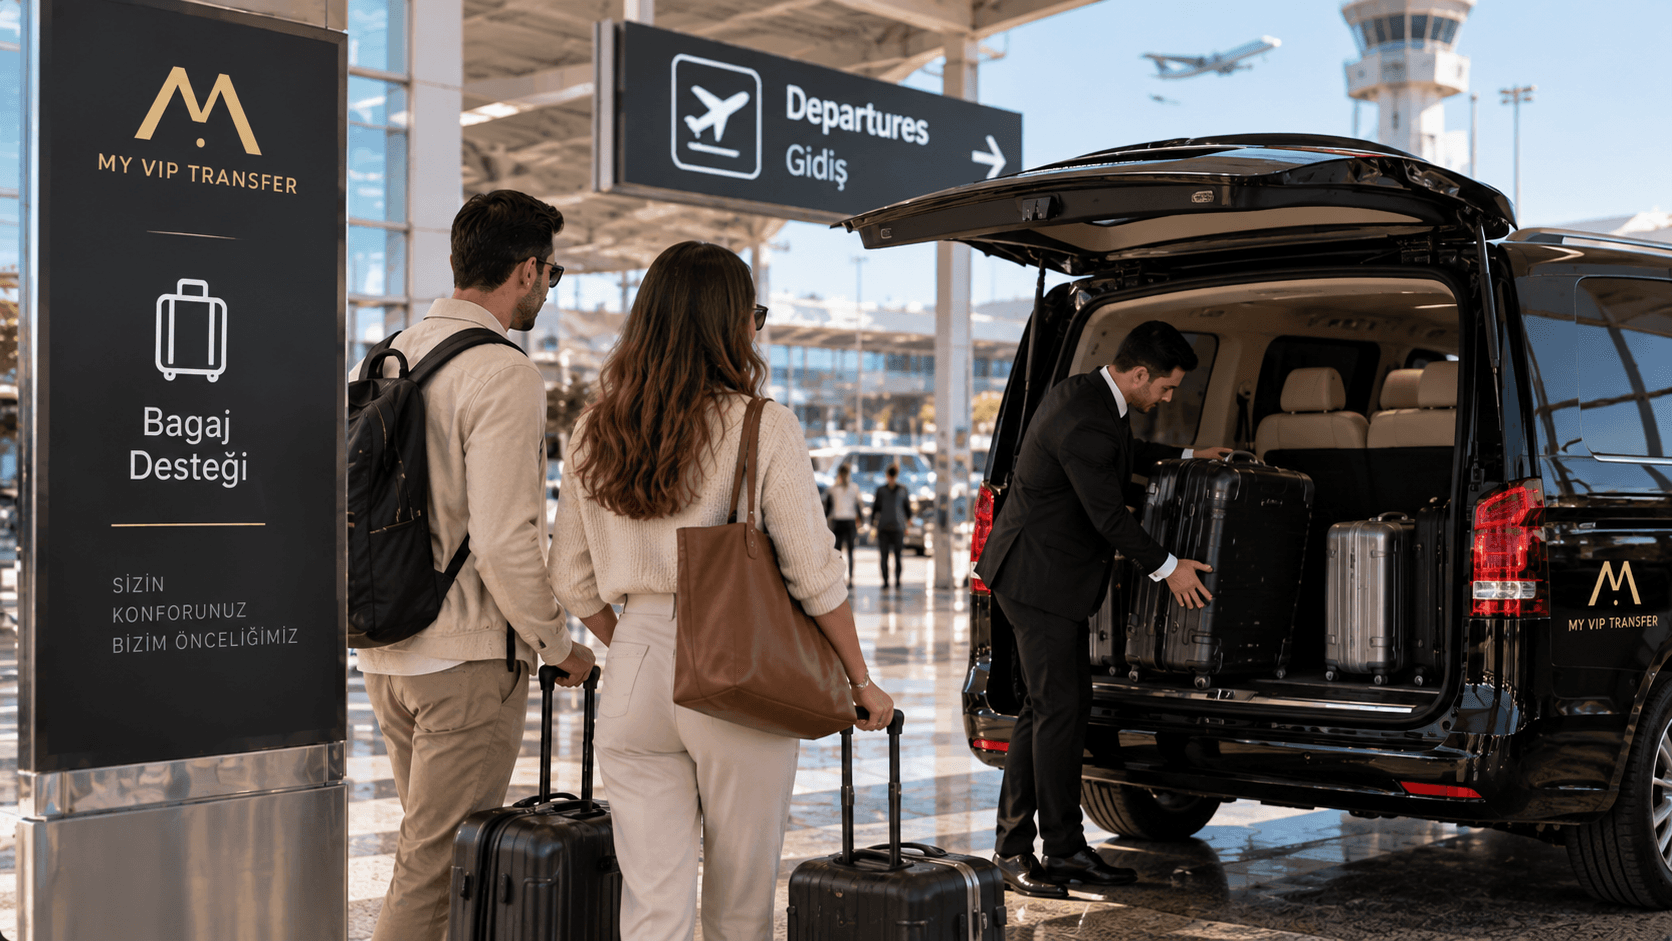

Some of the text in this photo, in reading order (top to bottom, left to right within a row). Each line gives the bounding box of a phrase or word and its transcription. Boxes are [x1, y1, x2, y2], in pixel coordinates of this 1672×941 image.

[786, 84, 930, 146] Departures
[98, 152, 297, 195] MY VIP TRANSFER
[786, 143, 849, 191] Gidiş
[143, 406, 231, 445] Bagaj
[130, 449, 248, 489] Desteği
[112, 573, 165, 594] SİZİN
[112, 601, 247, 624] KONFORUNUZ
[1568, 614, 1659, 632] MY VIP TRANSFER
[112, 625, 299, 654] BİZİM ÖNCELİĞİMİZ
